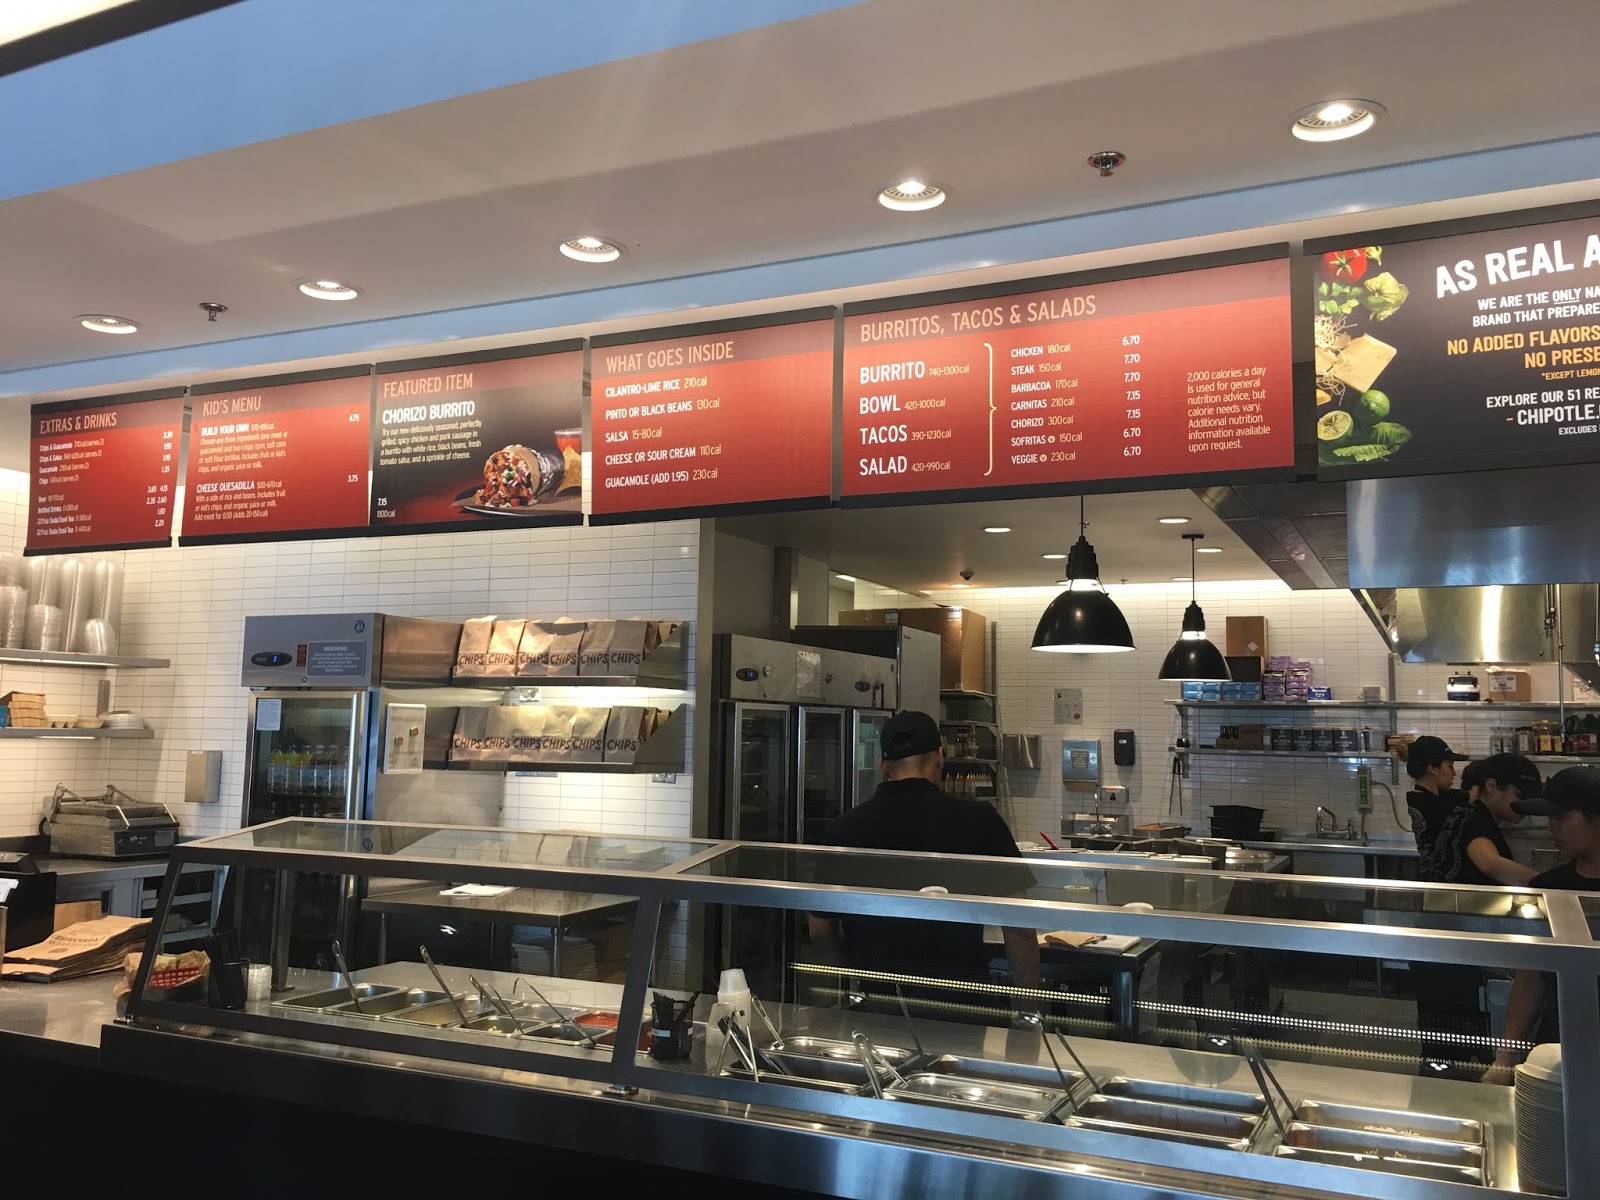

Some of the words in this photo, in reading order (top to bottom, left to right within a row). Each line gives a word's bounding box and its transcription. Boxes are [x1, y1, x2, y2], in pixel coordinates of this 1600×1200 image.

[1436, 259, 1477, 298] AS
[1485, 240, 1575, 285] REAL
[1478, 295, 1497, 310] WE
[1500, 293, 1523, 308] ARE
[1526, 291, 1549, 306] THE
[1552, 288, 1581, 303] ONLY
[861, 315, 945, 342] BURRITOS,
[951, 306, 1003, 331] TACOS
[1009, 305, 1021, 324] &
[1027, 295, 1097, 322] SALADS
[1473, 312, 1511, 327] BRAND
[1514, 309, 1544, 323] THAT
[1122, 335, 1140, 346] 6.70
[1447, 338, 1468, 355] NO
[1472, 333, 1524, 353] ADDED
[1529, 325, 1600, 347] FLAVORS
[606, 353, 643, 374] WHAT
[647, 347, 683, 369] GOES
[688, 341, 734, 364] INSIDE
[1011, 346, 1043, 358] CHICKEN
[1124, 353, 1140, 364] 7.70
[1524, 352, 1547, 368] NO
[860, 360, 925, 384] BURRITO
[1011, 364, 1035, 375] STEAK
[1187, 371, 1210, 382] 2,000
[1212, 368, 1242, 380] calories
[1244, 368, 1250, 377] a
[1251, 366, 1267, 376] day
[1124, 372, 1141, 382] 7.70
[384, 376, 442, 398] FEATURED
[446, 372, 473, 391] ITEM
[605, 381, 661, 398] CILANTRO-LIME
[663, 379, 680, 391] RICE
[1011, 381, 1051, 393] BARBACOA
[1187, 384, 1194, 393] is
[1196, 382, 1215, 393] used
[1217, 381, 1228, 391] for
[1230, 378, 1261, 391] general
[1126, 391, 1141, 400] 7.15
[1187, 394, 1221, 405] nutrition
[1223, 391, 1251, 402] advice,
[1252, 389, 1266, 399] but
[1486, 393, 1538, 408] EXPLORE
[1541, 391, 1564, 404] OUR
[1567, 389, 1581, 401] 51
[203, 399, 228, 416] KID'S
[231, 396, 262, 413] MENU
[605, 408, 627, 421] PINTO
[629, 406, 640, 418] OR
[641, 404, 666, 417] BLACK
[667, 400, 693, 414] BEANS
[860, 394, 901, 415] BOWL
[1011, 399, 1047, 411] CARNITAS
[1188, 406, 1214, 417] calorie
[1216, 404, 1240, 414] needs
[1242, 404, 1262, 414] vary.
[382, 405, 427, 425] CHORIZO
[429, 400, 475, 421] BURRITO
[1126, 409, 1141, 419] 7.15
[40, 417, 73, 435] EXTRAS
[75, 416, 82, 431] &
[84, 412, 117, 430] DRINKS
[382, 428, 390, 437] Try
[400, 427, 409, 435] new
[410, 424, 434, 434] deliciously
[460, 419, 482, 430] perfectly
[1011, 417, 1044, 428] CHORIZO
[1188, 416, 1227, 428] Additional
[1229, 414, 1263, 425] nutrition
[201, 426, 218, 436] BUILD
[219, 424, 235, 435] YOUR
[236, 423, 249, 433] OWN
[605, 431, 628, 443] SALSA
[632, 427, 662, 441] 15-80cal
[860, 424, 908, 445] TACOS
[1123, 427, 1141, 438] 6.70
[1188, 428, 1234, 440] information
[1235, 425, 1271, 437] available
[1558, 425, 1597, 435] EXCLUDES
[398, 436, 410, 445] spicy
[411, 434, 429, 443] chicken
[429, 433, 438, 441] and
[439, 432, 451, 442] pork
[452, 431, 472, 440] sausage
[473, 430, 478, 438] in
[1011, 435, 1046, 447] SOFRITAS
[385, 446, 402, 455] burrito
[402, 445, 412, 454] with
[413, 444, 426, 453] white
[438, 442, 450, 451] black
[468, 440, 481, 448] fresh
[1123, 446, 1141, 457] 6.70
[1188, 443, 1209, 453] upon
[1211, 439, 1243, 451] request.
[380, 457, 397, 466] tomato
[412, 455, 421, 463] and
[426, 453, 445, 463] sprinkle
[445, 452, 452, 460] of
[605, 453, 633, 466] CHEESE
[635, 451, 645, 463] OR
[647, 449, 668, 462] SOUR
[669, 446, 696, 460] CREAM
[1011, 454, 1038, 464] VEGGIE
[859, 455, 908, 476] SALAD
[605, 474, 649, 488] GUACAMOLE
[651, 472, 670, 486] (ADD
[671, 470, 689, 483] 1.95)
[196, 483, 219, 493] CHEESE
[219, 480, 255, 492] QUESADILLA
[459, 654, 485, 665] CHIPS
[488, 653, 515, 665] CHIPS
[519, 652, 549, 665] CHIPS
[551, 653, 577, 665] CHIPS
[580, 652, 609, 665] CHIPS
[611, 652, 641, 665] CHIPS
[454, 738, 482, 750] CHIPS
[484, 737, 511, 749] CHIPS
[513, 737, 542, 750] CHIPS
[543, 737, 571, 751] CHIPS
[572, 737, 602, 750] CHIPS
[607, 738, 637, 751] CHIPS
